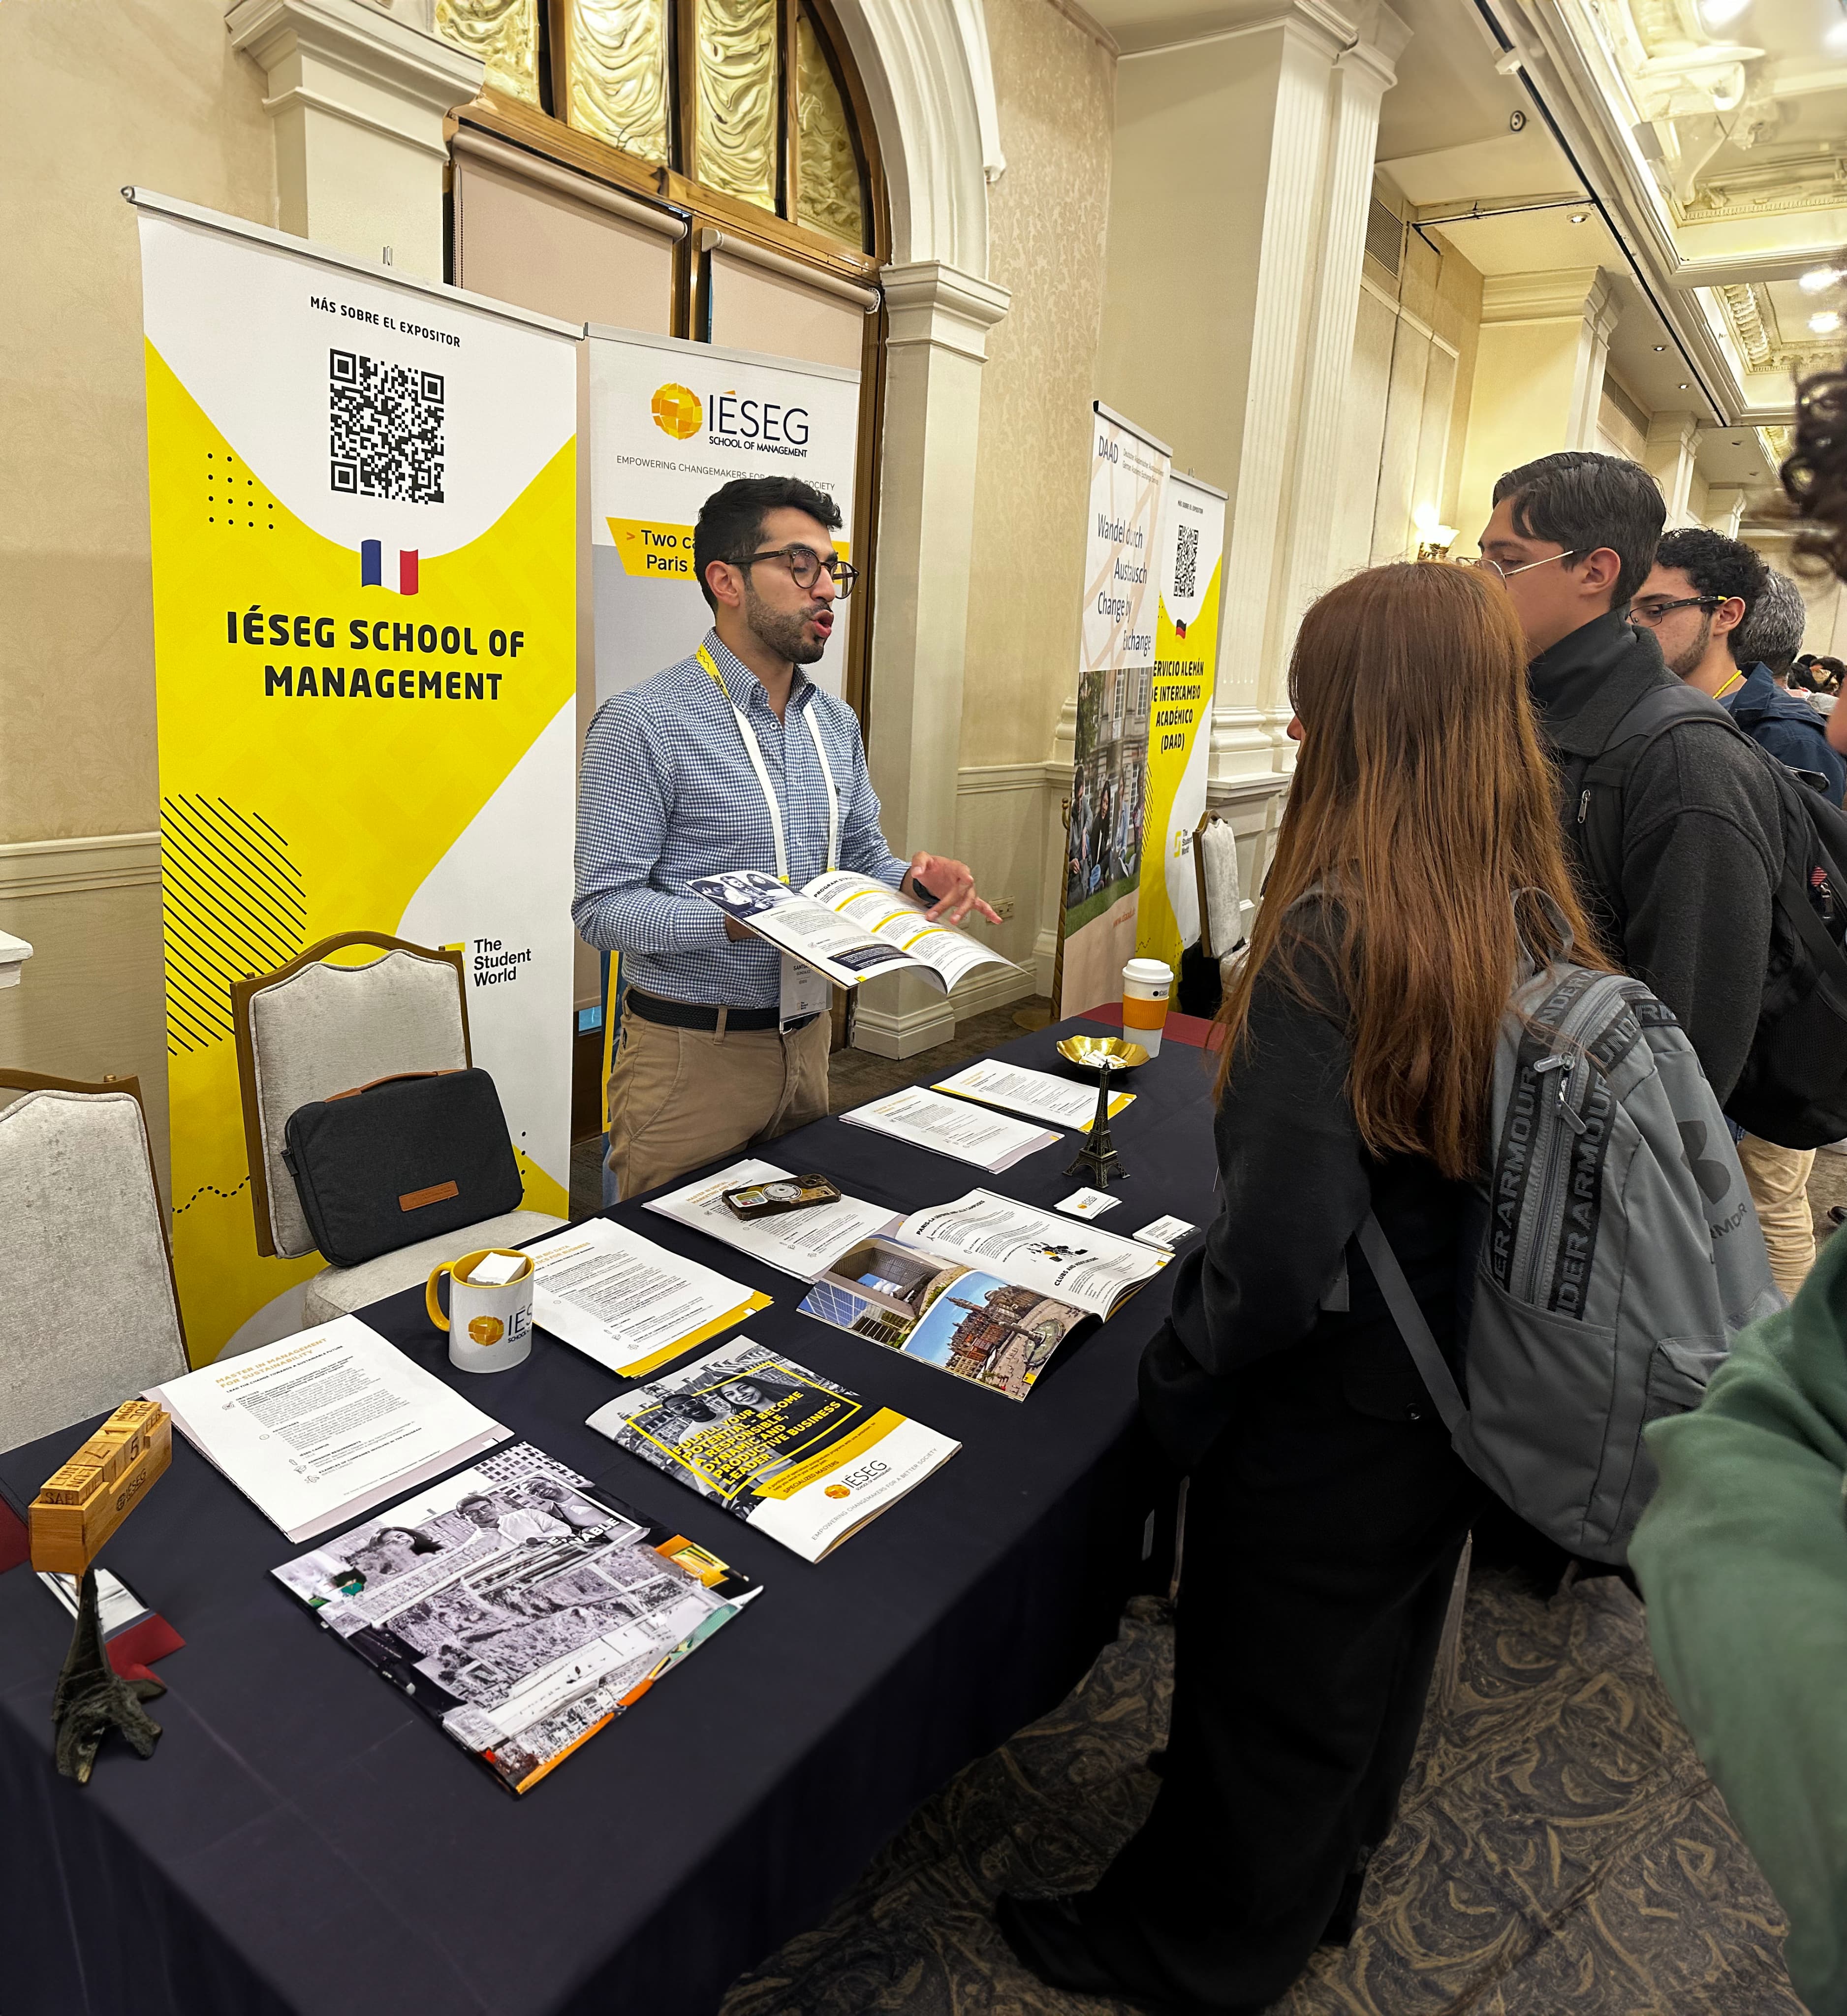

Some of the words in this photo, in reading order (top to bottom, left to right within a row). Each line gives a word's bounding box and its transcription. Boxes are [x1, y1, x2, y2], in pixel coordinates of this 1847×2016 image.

[311, 296, 336, 313] MÁS
[341, 305, 379, 325] SOBRE
[383, 316, 396, 330] EL
[400, 322, 460, 347] EXPOSITOR
[709, 389, 809, 445] IÉSEG
[709, 436, 742, 448] SCHOOL
[744, 441, 755, 451] OF
[757, 443, 808, 458] MANAGEMENT
[1098, 436, 1118, 464] DAAD
[617, 455, 676, 471] EMPOWERING
[678, 463, 747, 480] CHANGEMAKERS
[641, 529, 677, 549] Two
[1097, 513, 1125, 543] Wandel
[1126, 522, 1143, 549] durch
[646, 554, 688, 572] Paris
[1114, 557, 1147, 584] Austausch
[1098, 591, 1125, 623] Change
[1126, 593, 1132, 624] by
[227, 604, 335, 648] IÉSEG
[349, 619, 478, 656] SCHOOL
[489, 630, 524, 658] OF
[1123, 629, 1151, 657] Exchange
[1153, 661, 1180, 677] ERVICIO
[1181, 658, 1204, 676] ALEMÁN
[265, 665, 502, 700] MANAGEMENT
[1159, 685, 1201, 702] INTERCAMBIO
[1156, 706, 1193, 727] ACADÉMICO
[1161, 733, 1185, 754] (DAAD)
[814, 880, 839, 898] PROGRAM
[473, 938, 502, 953] The
[474, 948, 531, 970] Student
[473, 966, 516, 987] World
[687, 1191, 704, 1201] MASTER
[692, 1190, 717, 1203] MARKETING
[916, 1215, 936, 1235] PARIS-LA
[562, 1242, 590, 1255] BUSINESS
[1054, 1270, 1068, 1287] CLUBS
[508, 1303, 532, 1336] IÉS
[216, 1367, 252, 1383] MASTER
[267, 1338, 325, 1364] MANAGEMENT
[220, 1378, 240, 1387] FOR
[242, 1350, 312, 1379] SUSTAINABILITY
[250, 1375, 269, 1384] CHANGE
[269, 1366, 292, 1376] TOWARDS
[297, 1352, 326, 1365] SUSTAINABLE
[326, 1345, 343, 1354] FUTURE
[672, 1427, 720, 1454] FULFILL
[722, 1409, 754, 1428] YOUR
[683, 1418, 748, 1462] POTENTIAL
[757, 1392, 802, 1419] BECOME
[694, 1458, 705, 1466] A
[705, 1409, 783, 1461] RESPONSIBLE,
[130, 1437, 139, 1461] 5
[318, 1463, 341, 1474] EXAMPLES
[347, 1450, 371, 1462] COMPANIES
[370, 1442, 390, 1451] INVOLVED
[402, 1427, 422, 1437] PROGRAM
[703, 1435, 756, 1473] DYNAMIC
[760, 1424, 785, 1440] AND
[713, 1430, 787, 1481] PRODUCTIVE
[787, 1402, 840, 1435] BUSINESS
[50, 1467, 79, 1485] LUN
[724, 1453, 770, 1484] LEADER
[782, 1471, 817, 1495] SPECIALIZED
[814, 1458, 840, 1477] MASTERS
[841, 1460, 887, 1490] IÉSEG
[811, 1511, 848, 1541] EMPOWERING
[846, 1486, 887, 1512] CHANGEMAKERS
[885, 1480, 898, 1488] FOR
[900, 1464, 919, 1479] BETTER
[917, 1448, 937, 1465] SOCIETY
